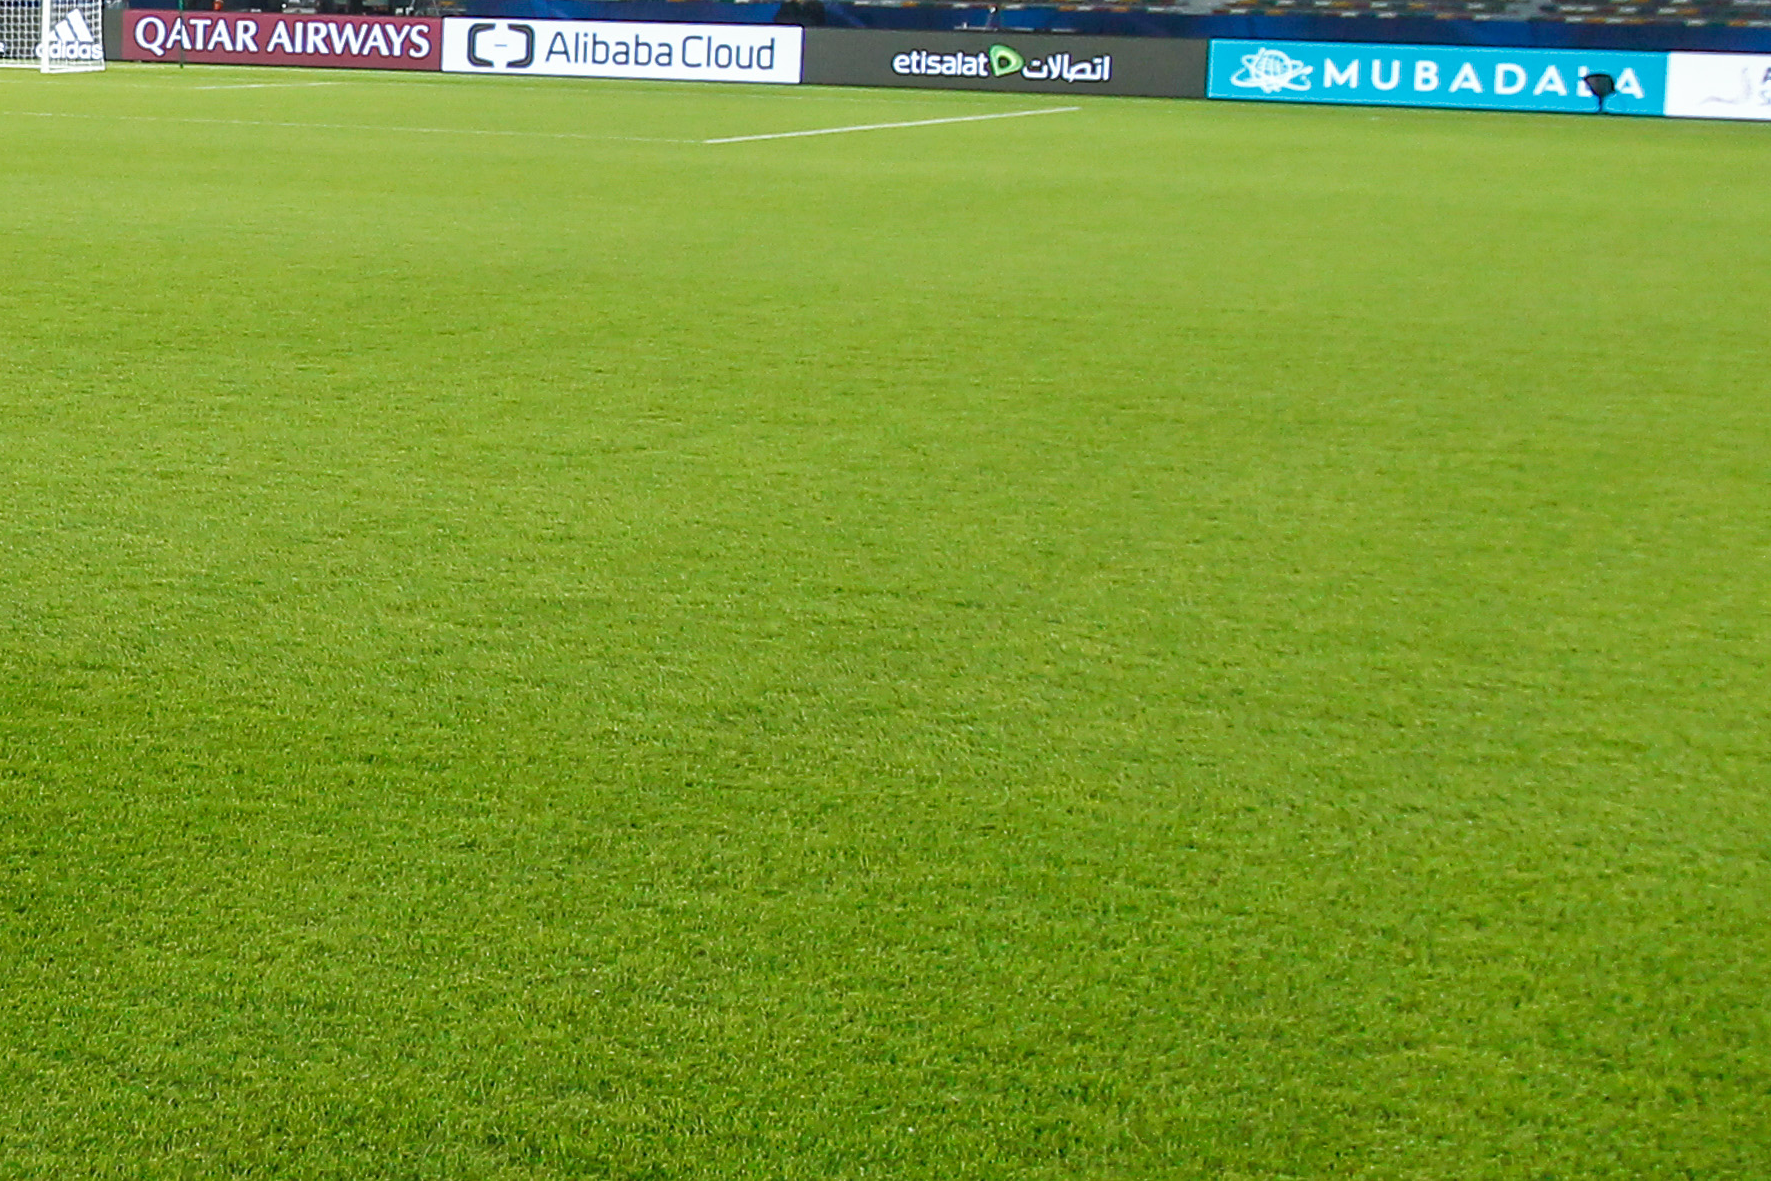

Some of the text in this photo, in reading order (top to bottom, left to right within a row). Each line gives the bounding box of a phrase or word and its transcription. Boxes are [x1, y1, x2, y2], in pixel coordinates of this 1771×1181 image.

[135, 16, 430, 58] QATAR AIRWAYS
[545, 31, 775, 70] Alibaba Cloud
[892, 50, 989, 76] etisalat
[1022, 53, 1111, 82] اتصالات
[1323, 59, 1645, 100] MUBADALA
